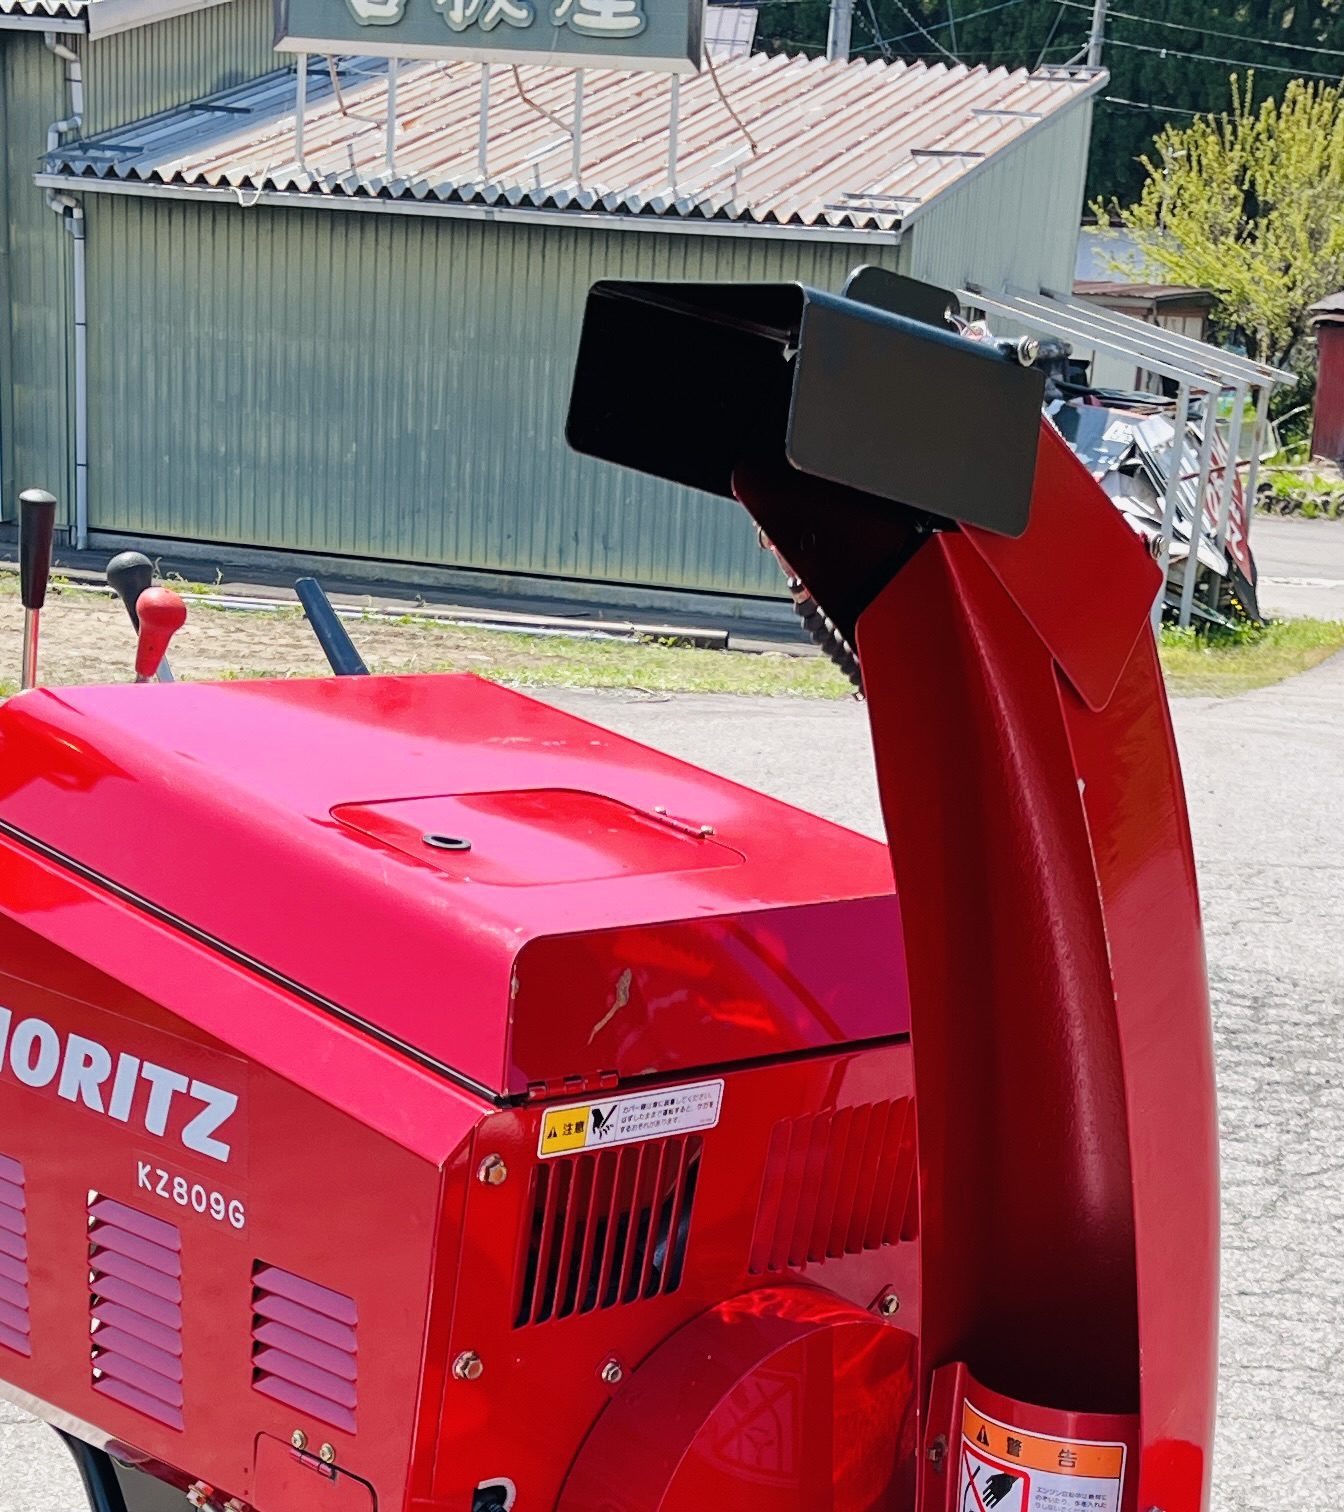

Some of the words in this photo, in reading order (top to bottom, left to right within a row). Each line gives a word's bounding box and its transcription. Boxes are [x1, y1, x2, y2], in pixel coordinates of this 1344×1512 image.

[562, 1120, 585, 1136] 注意
[137, 1161, 246, 1229] KZ809G
[1007, 1436, 1077, 1468] 警告
